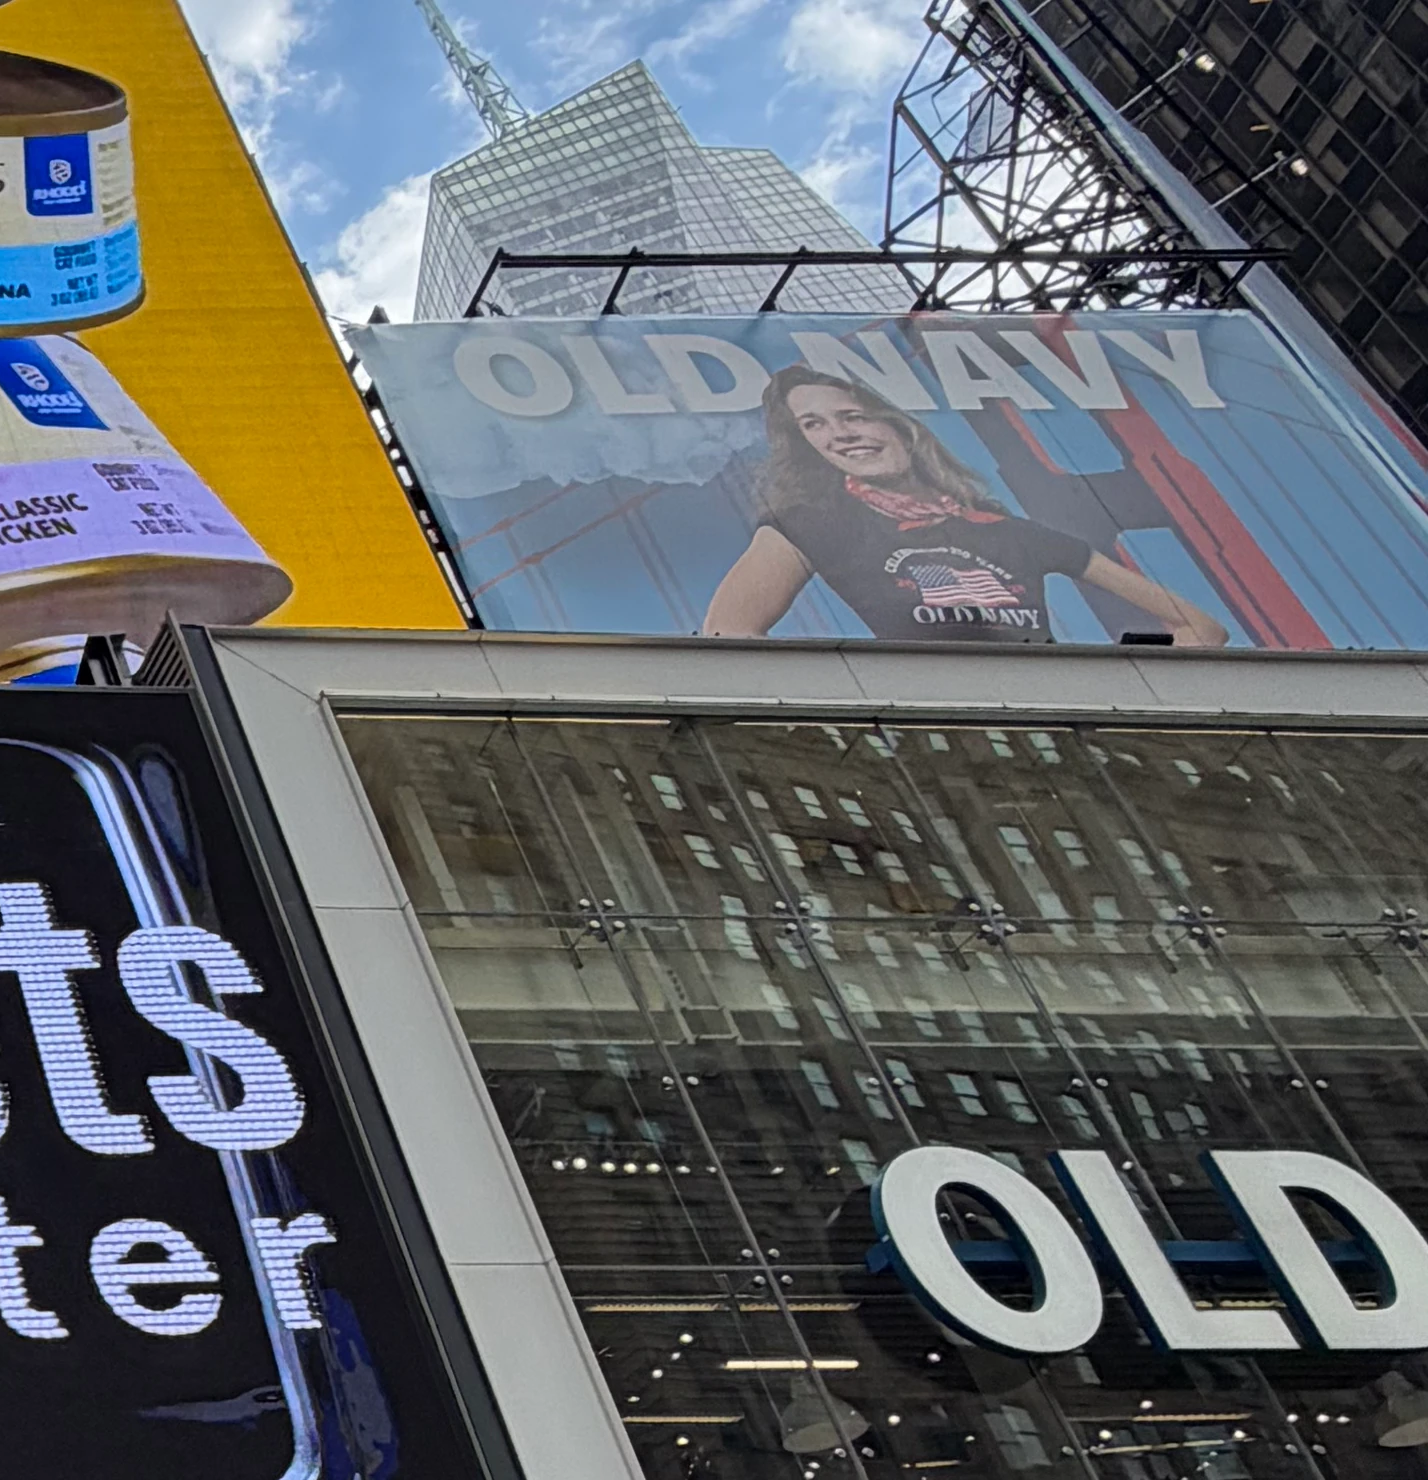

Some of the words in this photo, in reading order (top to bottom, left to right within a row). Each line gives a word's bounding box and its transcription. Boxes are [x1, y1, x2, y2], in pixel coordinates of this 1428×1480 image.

[452, 331, 770, 418] OLD
[786, 327, 1227, 412] NAVY
[912, 604, 974, 625] OLD
[975, 605, 1040, 630] NAVY
[870, 1145, 1428, 1357] OLD
